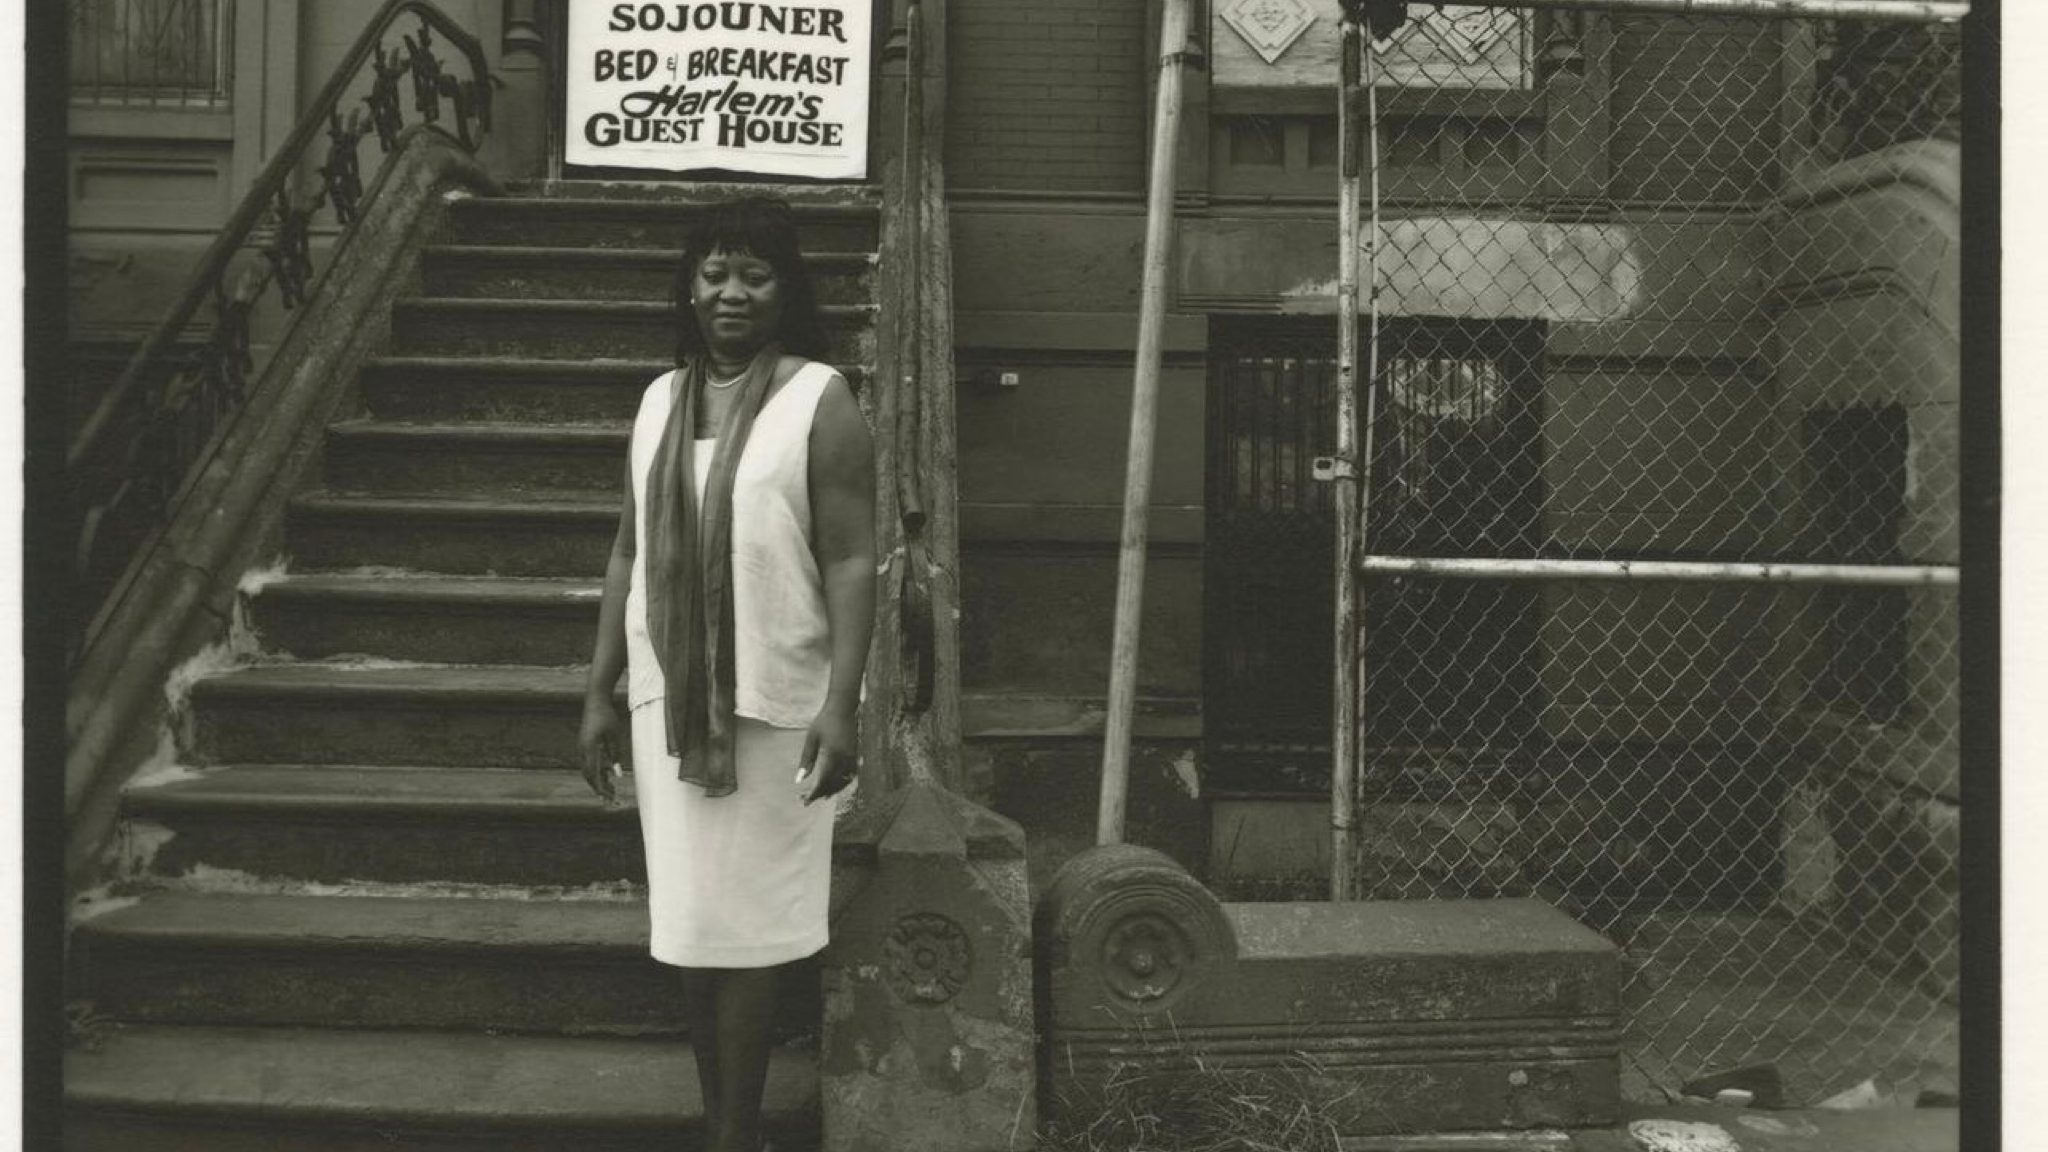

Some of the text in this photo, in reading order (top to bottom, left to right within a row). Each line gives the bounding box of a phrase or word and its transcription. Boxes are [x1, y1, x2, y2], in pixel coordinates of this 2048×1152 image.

[609, 2, 848, 43] SOJOUNER
[594, 47, 850, 86] BED & BREAKFAST
[620, 80, 823, 121] Harlem's
[584, 112, 843, 148] GUEST HOUSE
